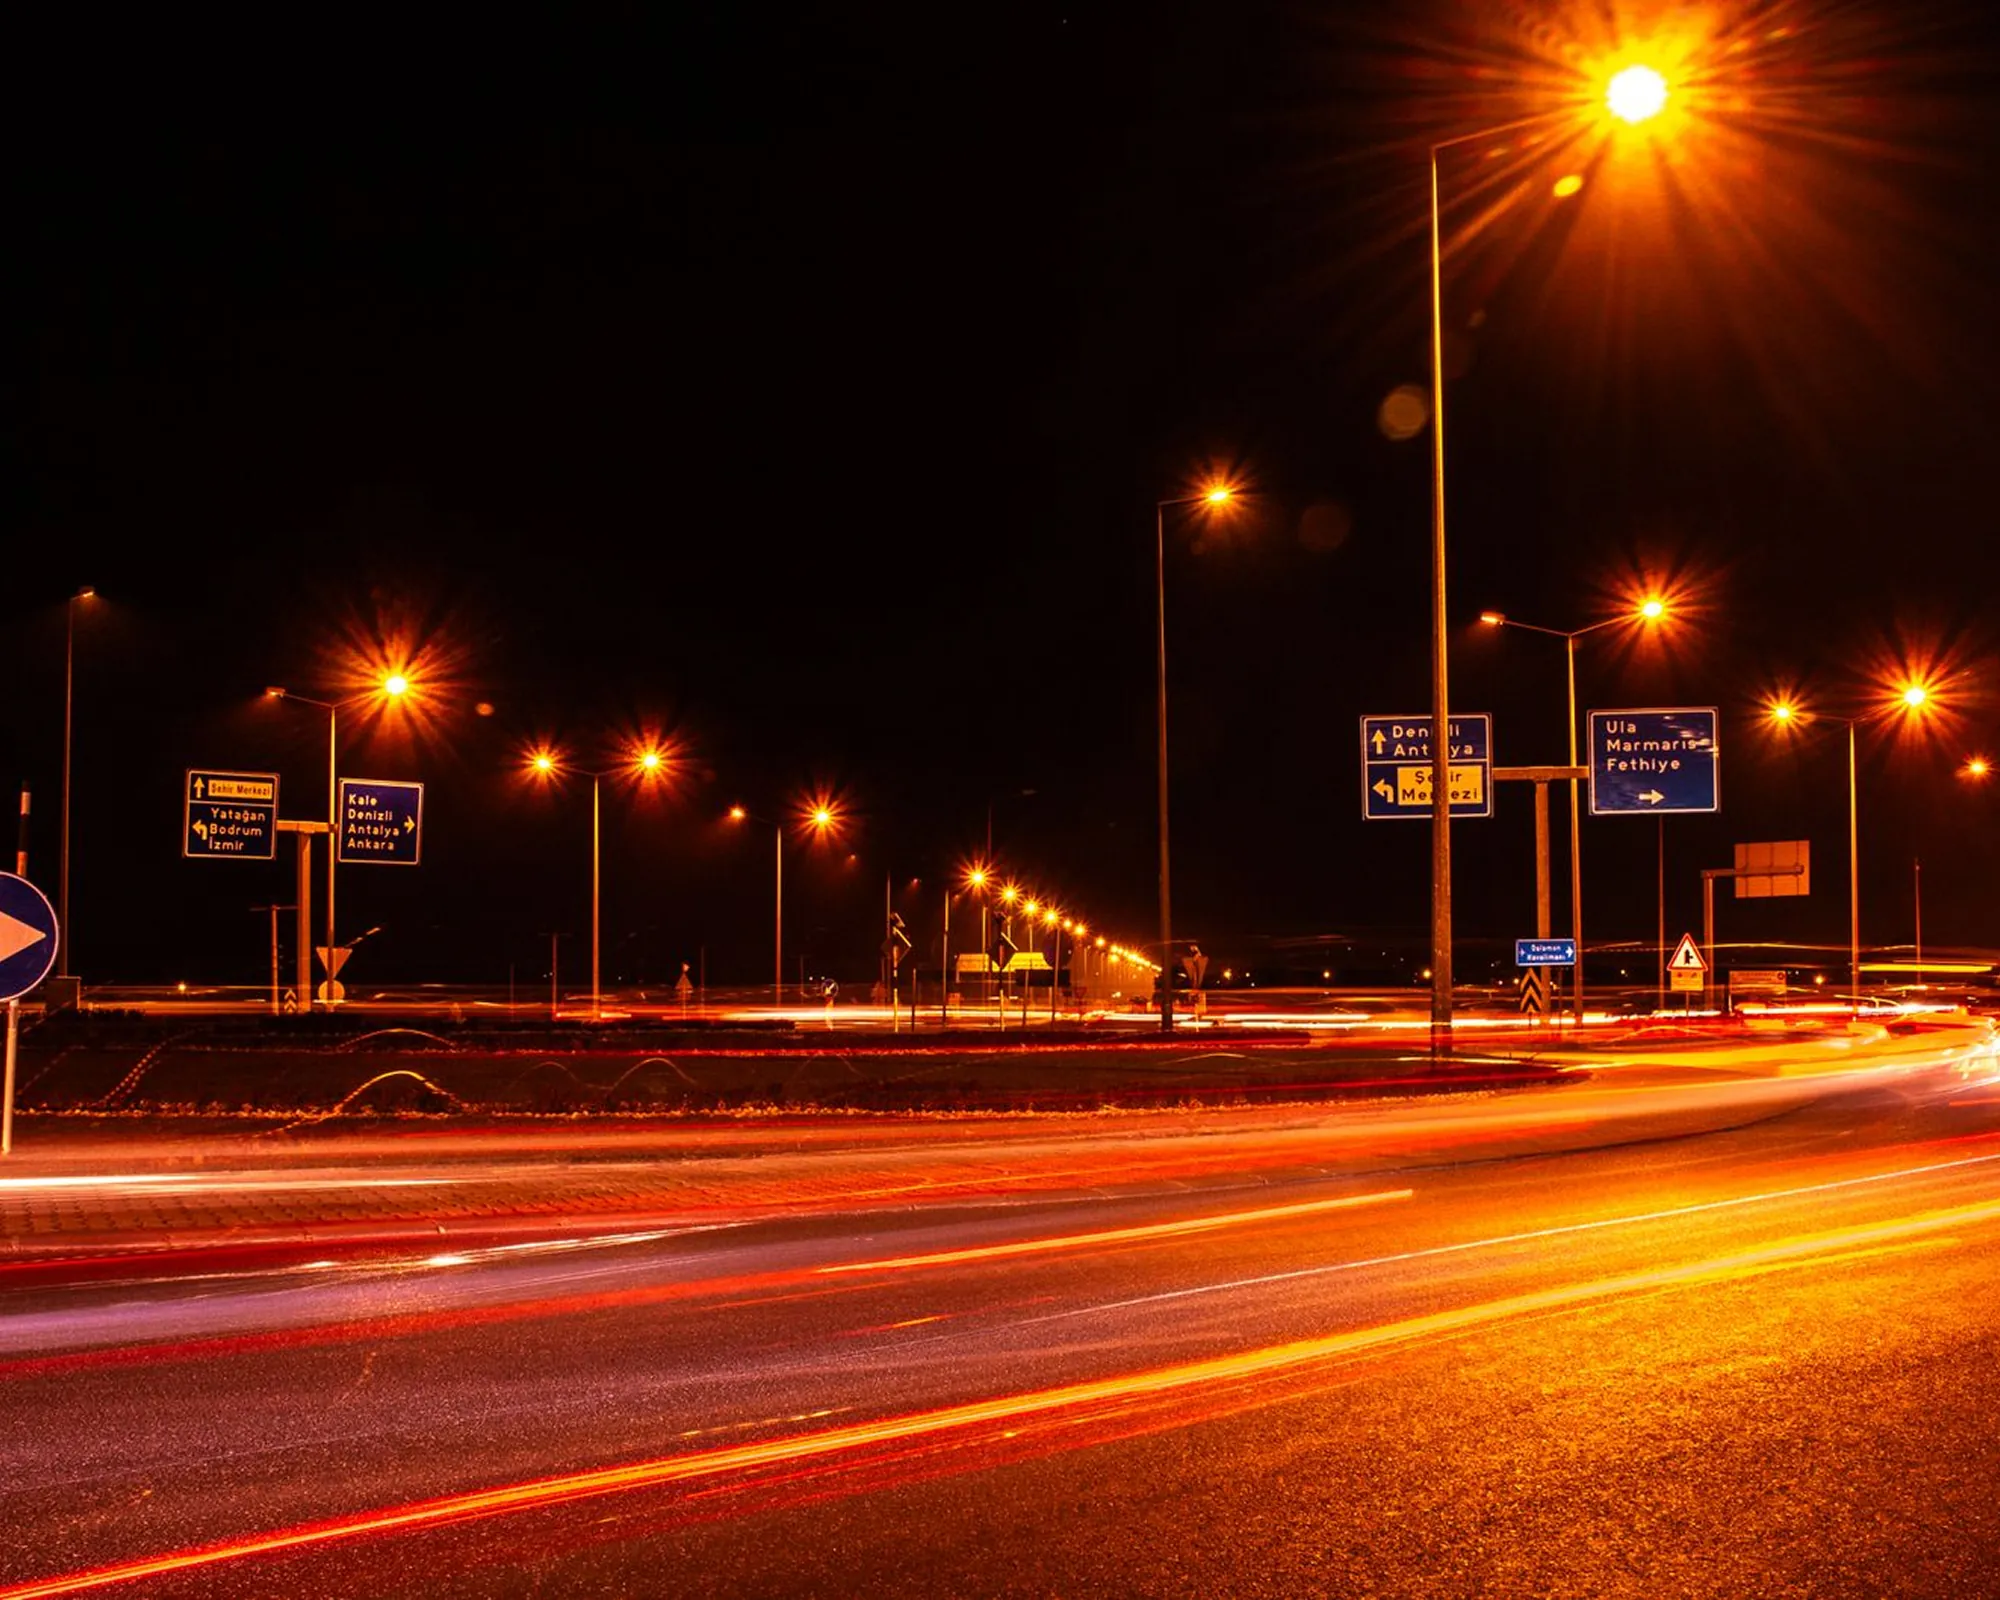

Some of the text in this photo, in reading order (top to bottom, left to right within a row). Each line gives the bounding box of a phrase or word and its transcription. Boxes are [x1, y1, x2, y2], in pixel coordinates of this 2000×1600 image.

[1606, 721, 1636, 734] Ula
[1394, 743, 1473, 758] Antya
[1606, 738, 1697, 752] Marmaris
[1607, 758, 1680, 774] Fethiye
[236, 785, 270, 796] Merkezi
[349, 794, 377, 806] Kale
[211, 807, 265, 823] Yatağan
[348, 808, 393, 821] Denizli
[210, 823, 263, 837] Bodrum
[348, 823, 399, 838] Antalya
[348, 837, 394, 851] Ankara
